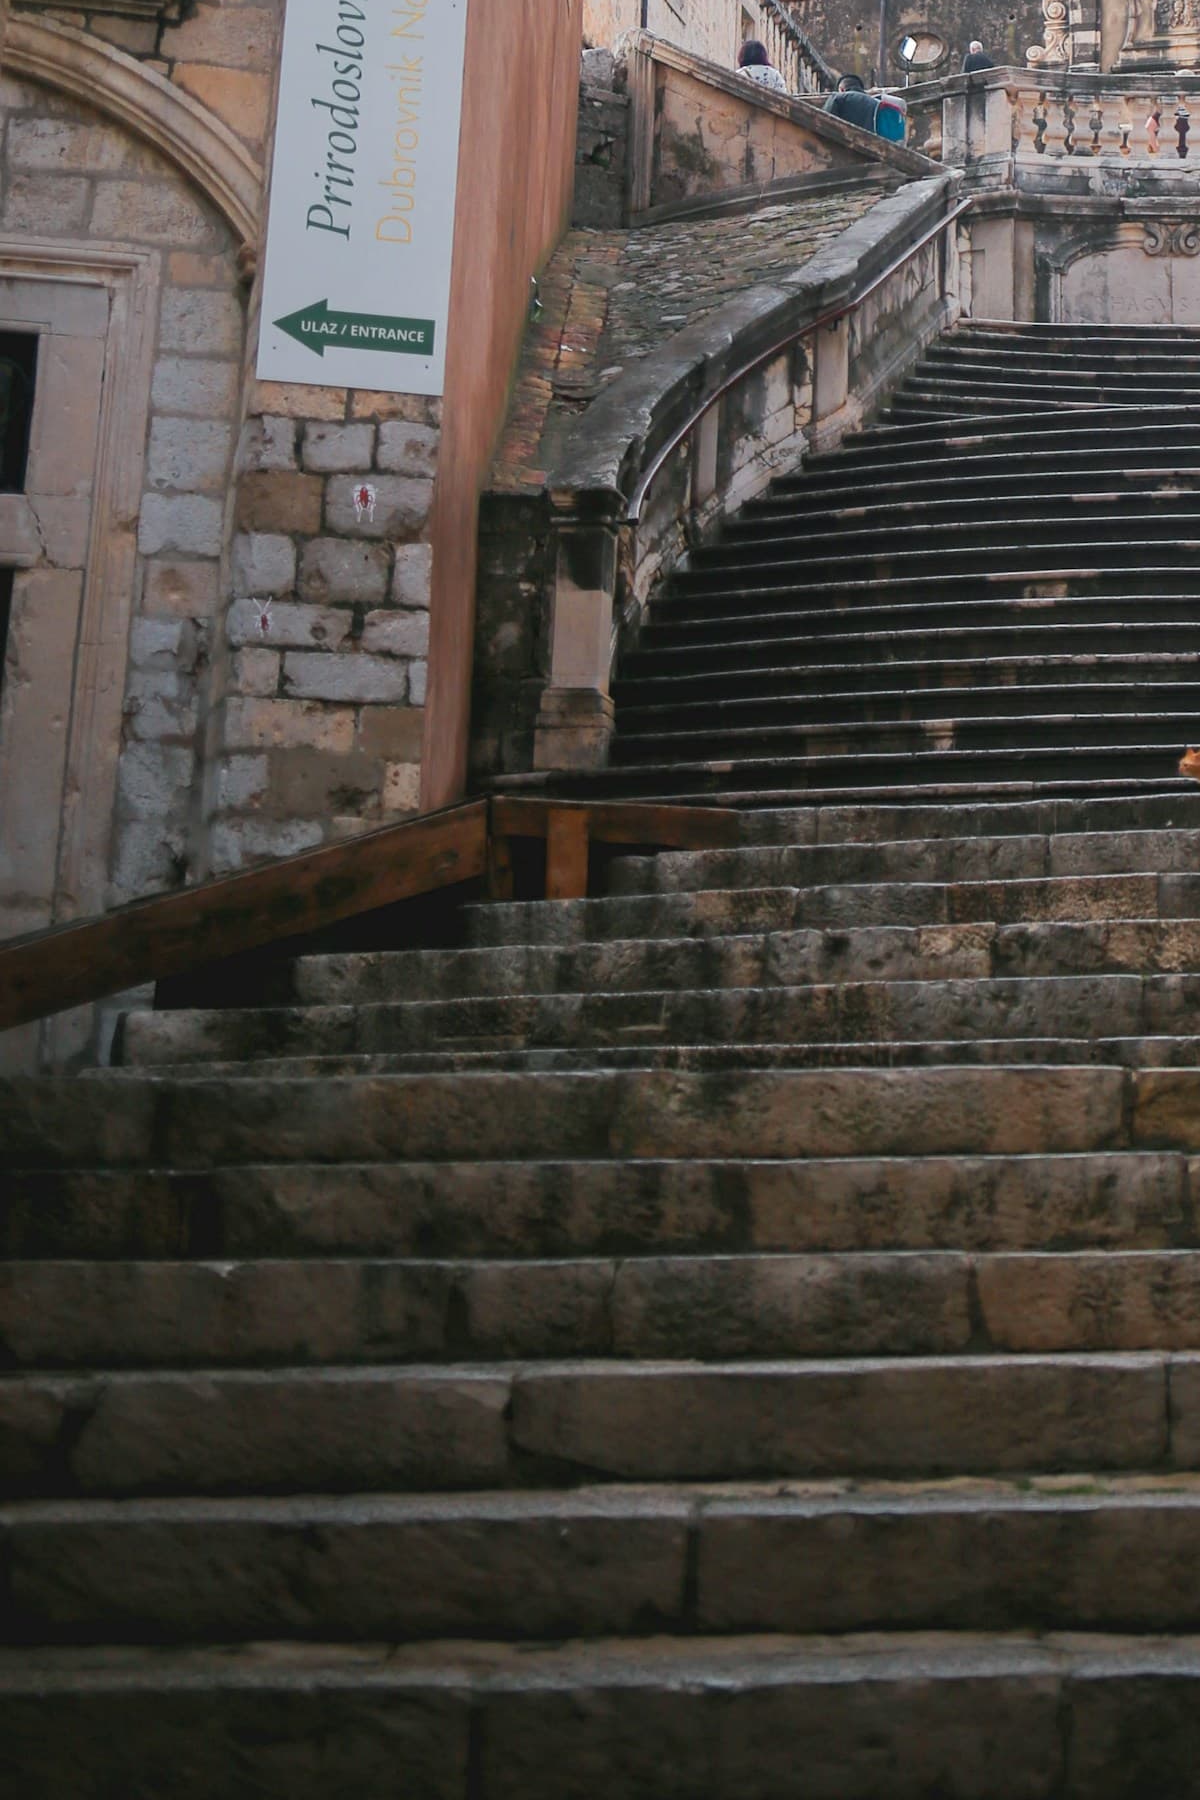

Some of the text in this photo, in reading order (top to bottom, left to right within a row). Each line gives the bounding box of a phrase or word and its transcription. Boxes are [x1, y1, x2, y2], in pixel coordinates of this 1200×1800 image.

[375, 54, 424, 245] Dubrovnik
[301, 320, 425, 343] ULAZ / ENTRANCE
